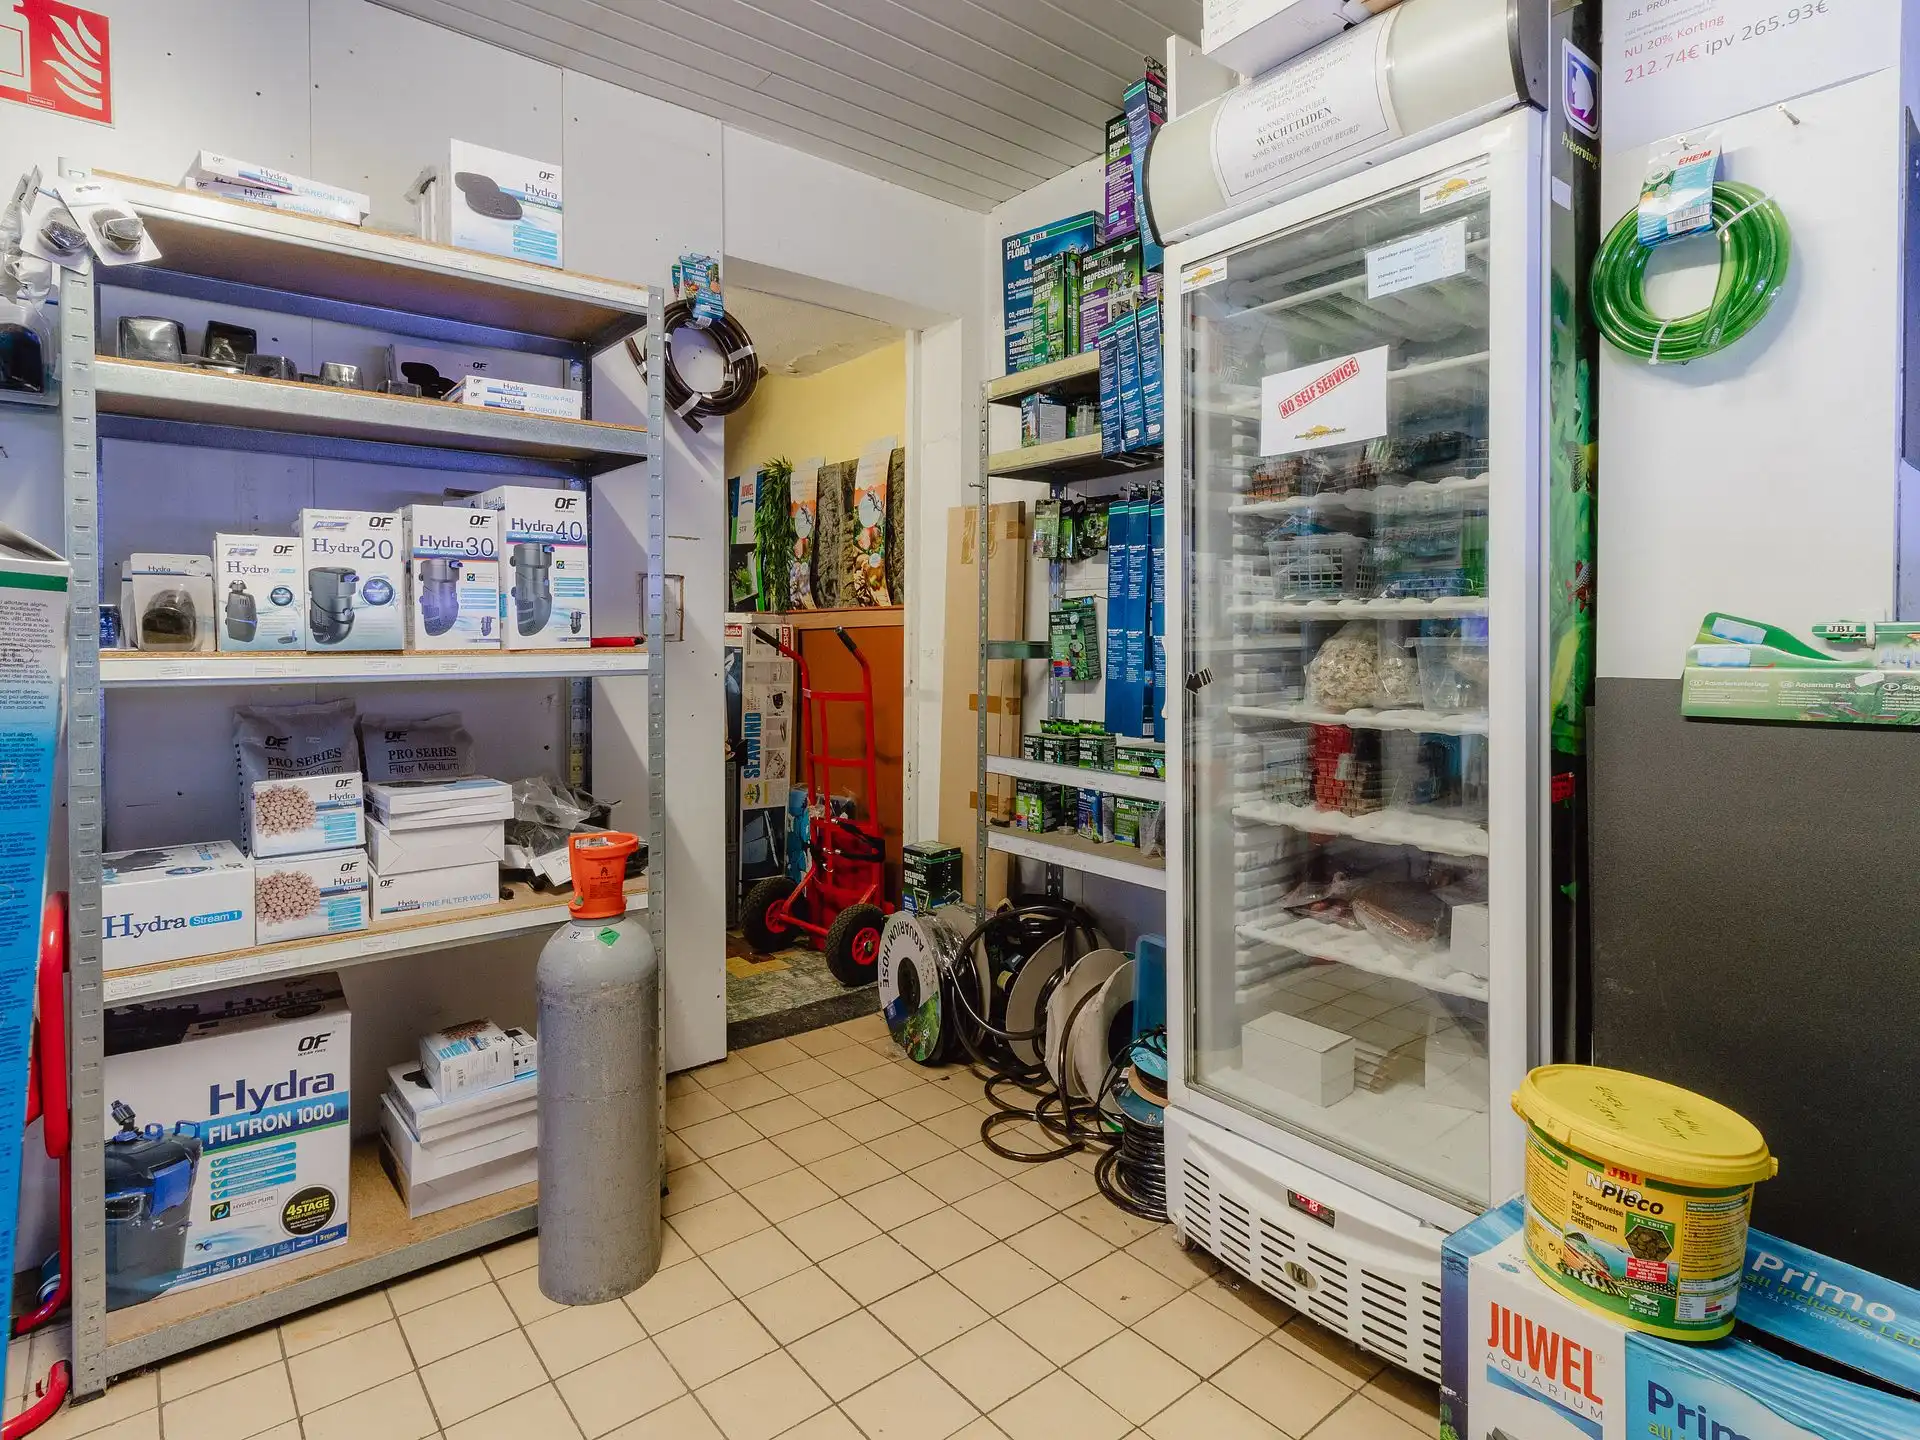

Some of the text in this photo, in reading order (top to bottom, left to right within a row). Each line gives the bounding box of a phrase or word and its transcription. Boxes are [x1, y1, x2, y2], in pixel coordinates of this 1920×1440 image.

[1626, 8, 1643, 20] JBL
[1624, 0, 1829, 83] 212.74€ ipv 265.93€
[1624, 44, 1642, 58] NU
[1648, 32, 1672, 50] 20%
[1110, 122, 1120, 132] PRO
[1110, 126, 1125, 139] FLORA
[1256, 106, 1333, 147] WACHTTIJDEN
[1678, 150, 1712, 166] EHEIM
[260, 168, 289, 182] Hydra
[538, 170, 555, 180] OF
[244, 188, 273, 200] Hydra
[525, 182, 558, 200] Hydra
[1006, 238, 1021, 250] PRO
[1006, 244, 1032, 260] FLORA
[472, 362, 488, 370] OF
[503, 382, 524, 392] Hydra
[1280, 360, 1358, 416] NO SELF SERVICE
[500, 396, 522, 404] Hydra
[554, 497, 577, 510] OF
[369, 516, 394, 528] OF
[470, 515, 491, 526] OF
[511, 518, 583, 542] Hydra 40
[273, 545, 295, 554] OF
[311, 538, 394, 560] Hydra 20
[420, 535, 494, 558] Hydra 30
[148, 565, 171, 573] Hydra
[226, 561, 270, 574] Hydra
[1828, 625, 1854, 633] JBL
[1795, 681, 1834, 690] Aquarium
[264, 736, 290, 747] OF
[384, 731, 408, 741] OF
[744, 712, 762, 779] SEAWIND
[267, 748, 342, 769] PRO SERIES
[388, 746, 457, 761] PRO SERIES
[298, 764, 344, 778] Medium
[389, 761, 460, 774] Filter Medium
[336, 778, 353, 788] OF
[329, 793, 356, 802] Hydra
[340, 862, 360, 872] OF
[334, 876, 362, 886] Hydra
[380, 878, 396, 888] OF
[422, 900, 440, 908] FINE
[442, 896, 468, 906] FILTER
[470, 892, 492, 903] WOOL
[102, 911, 238, 940] Hydra Stream 1
[888, 920, 924, 953] AQUARIUM
[882, 947, 890, 988] HOSE
[298, 1032, 332, 1052] OF
[210, 1069, 335, 1116] Hydra
[208, 1102, 335, 1144] FILTRON 1000
[1608, 1168, 1642, 1185] JBL
[1572, 1191, 1624, 1218] Für Saugwelse
[1572, 1200, 1584, 1210] For
[1601, 1185, 1664, 1216] Pleco
[1571, 1216, 1594, 1231] catfish
[1572, 1209, 1618, 1233] suckermouth
[1633, 1216, 1669, 1230] JBL CHIPS
[1752, 1252, 1896, 1322] Primo
[1744, 1274, 1771, 1288] all
[1778, 1285, 1872, 1328] inclusive
[1487, 1301, 1604, 1406] JUWEL
[1486, 1352, 1604, 1420] AQUARIUM
